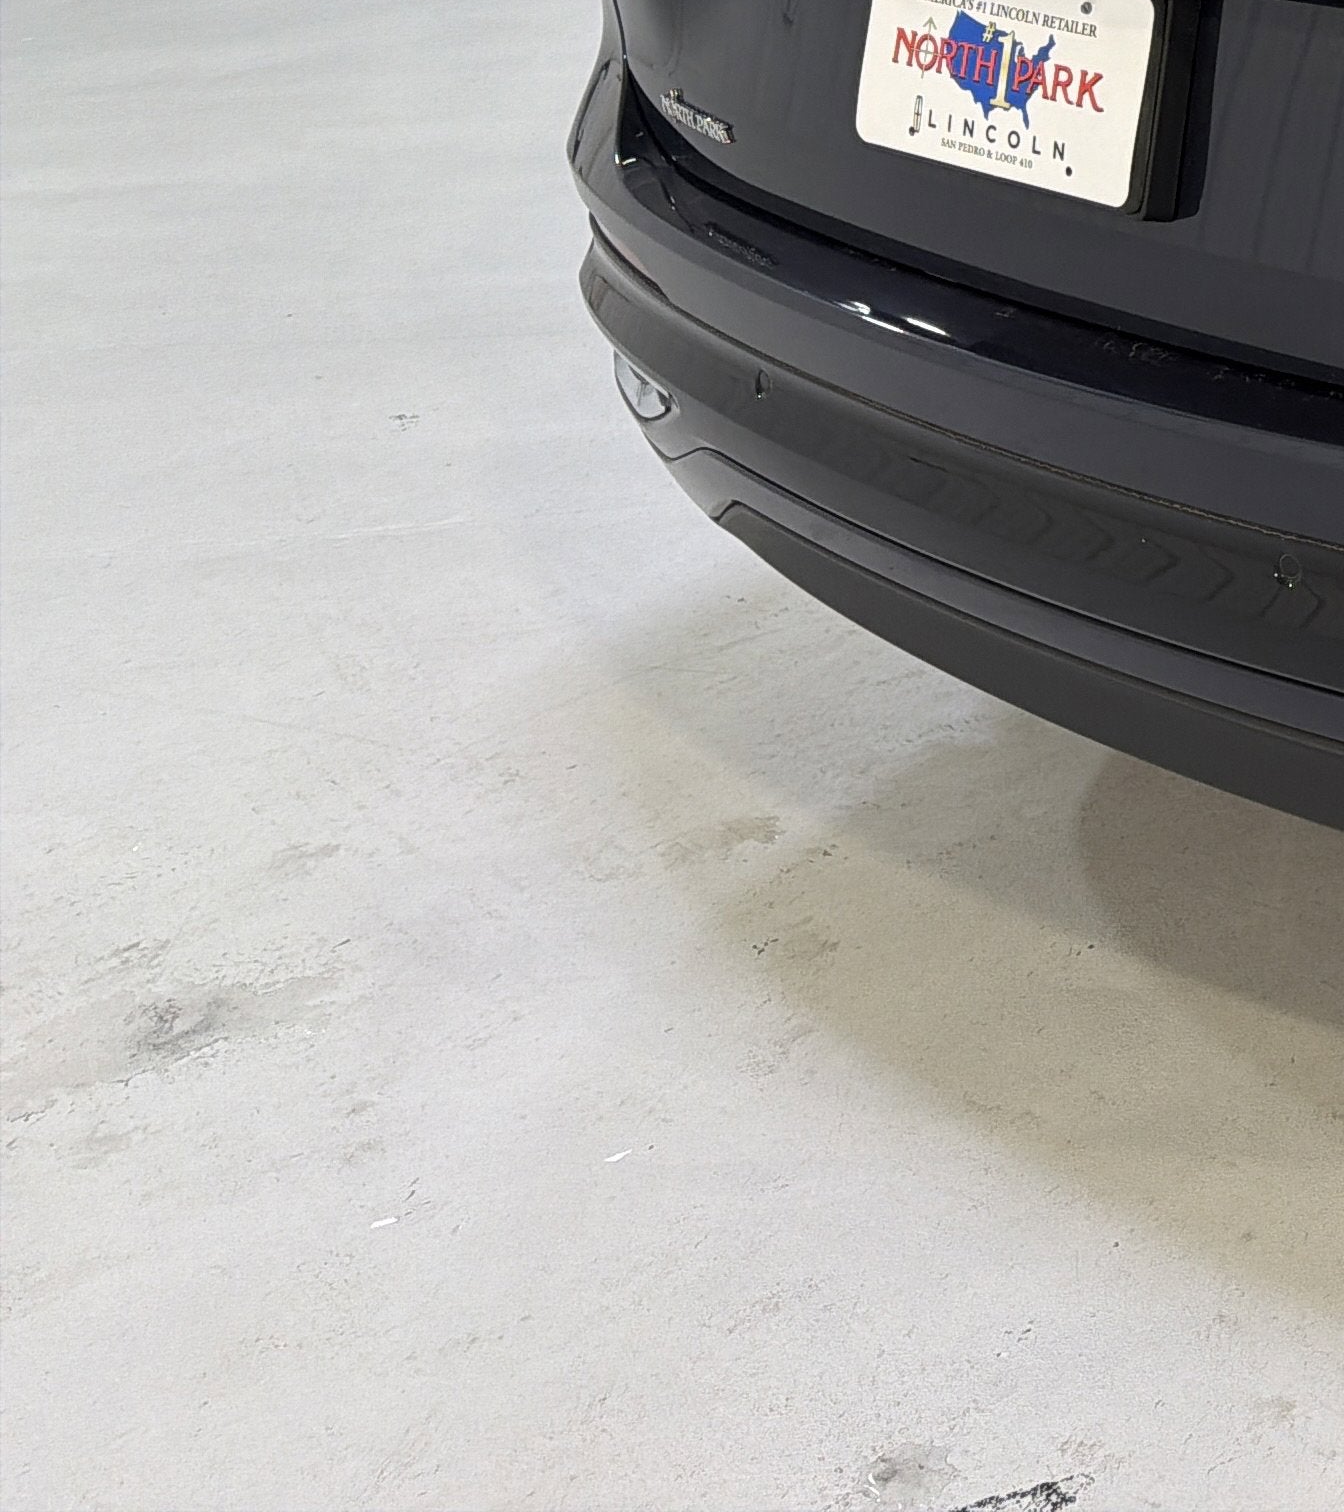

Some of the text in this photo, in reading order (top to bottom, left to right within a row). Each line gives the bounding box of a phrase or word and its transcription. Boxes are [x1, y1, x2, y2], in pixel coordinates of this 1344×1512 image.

[990, 2, 1041, 25] LINCOLN
[1042, 14, 1098, 38] RETAILER
[892, 27, 998, 86] NORTH
[1011, 56, 1105, 113] PARK
[927, 109, 1066, 162] LINCOLN
[940, 137, 1033, 169] SAN PEDRO & LOOP 410
